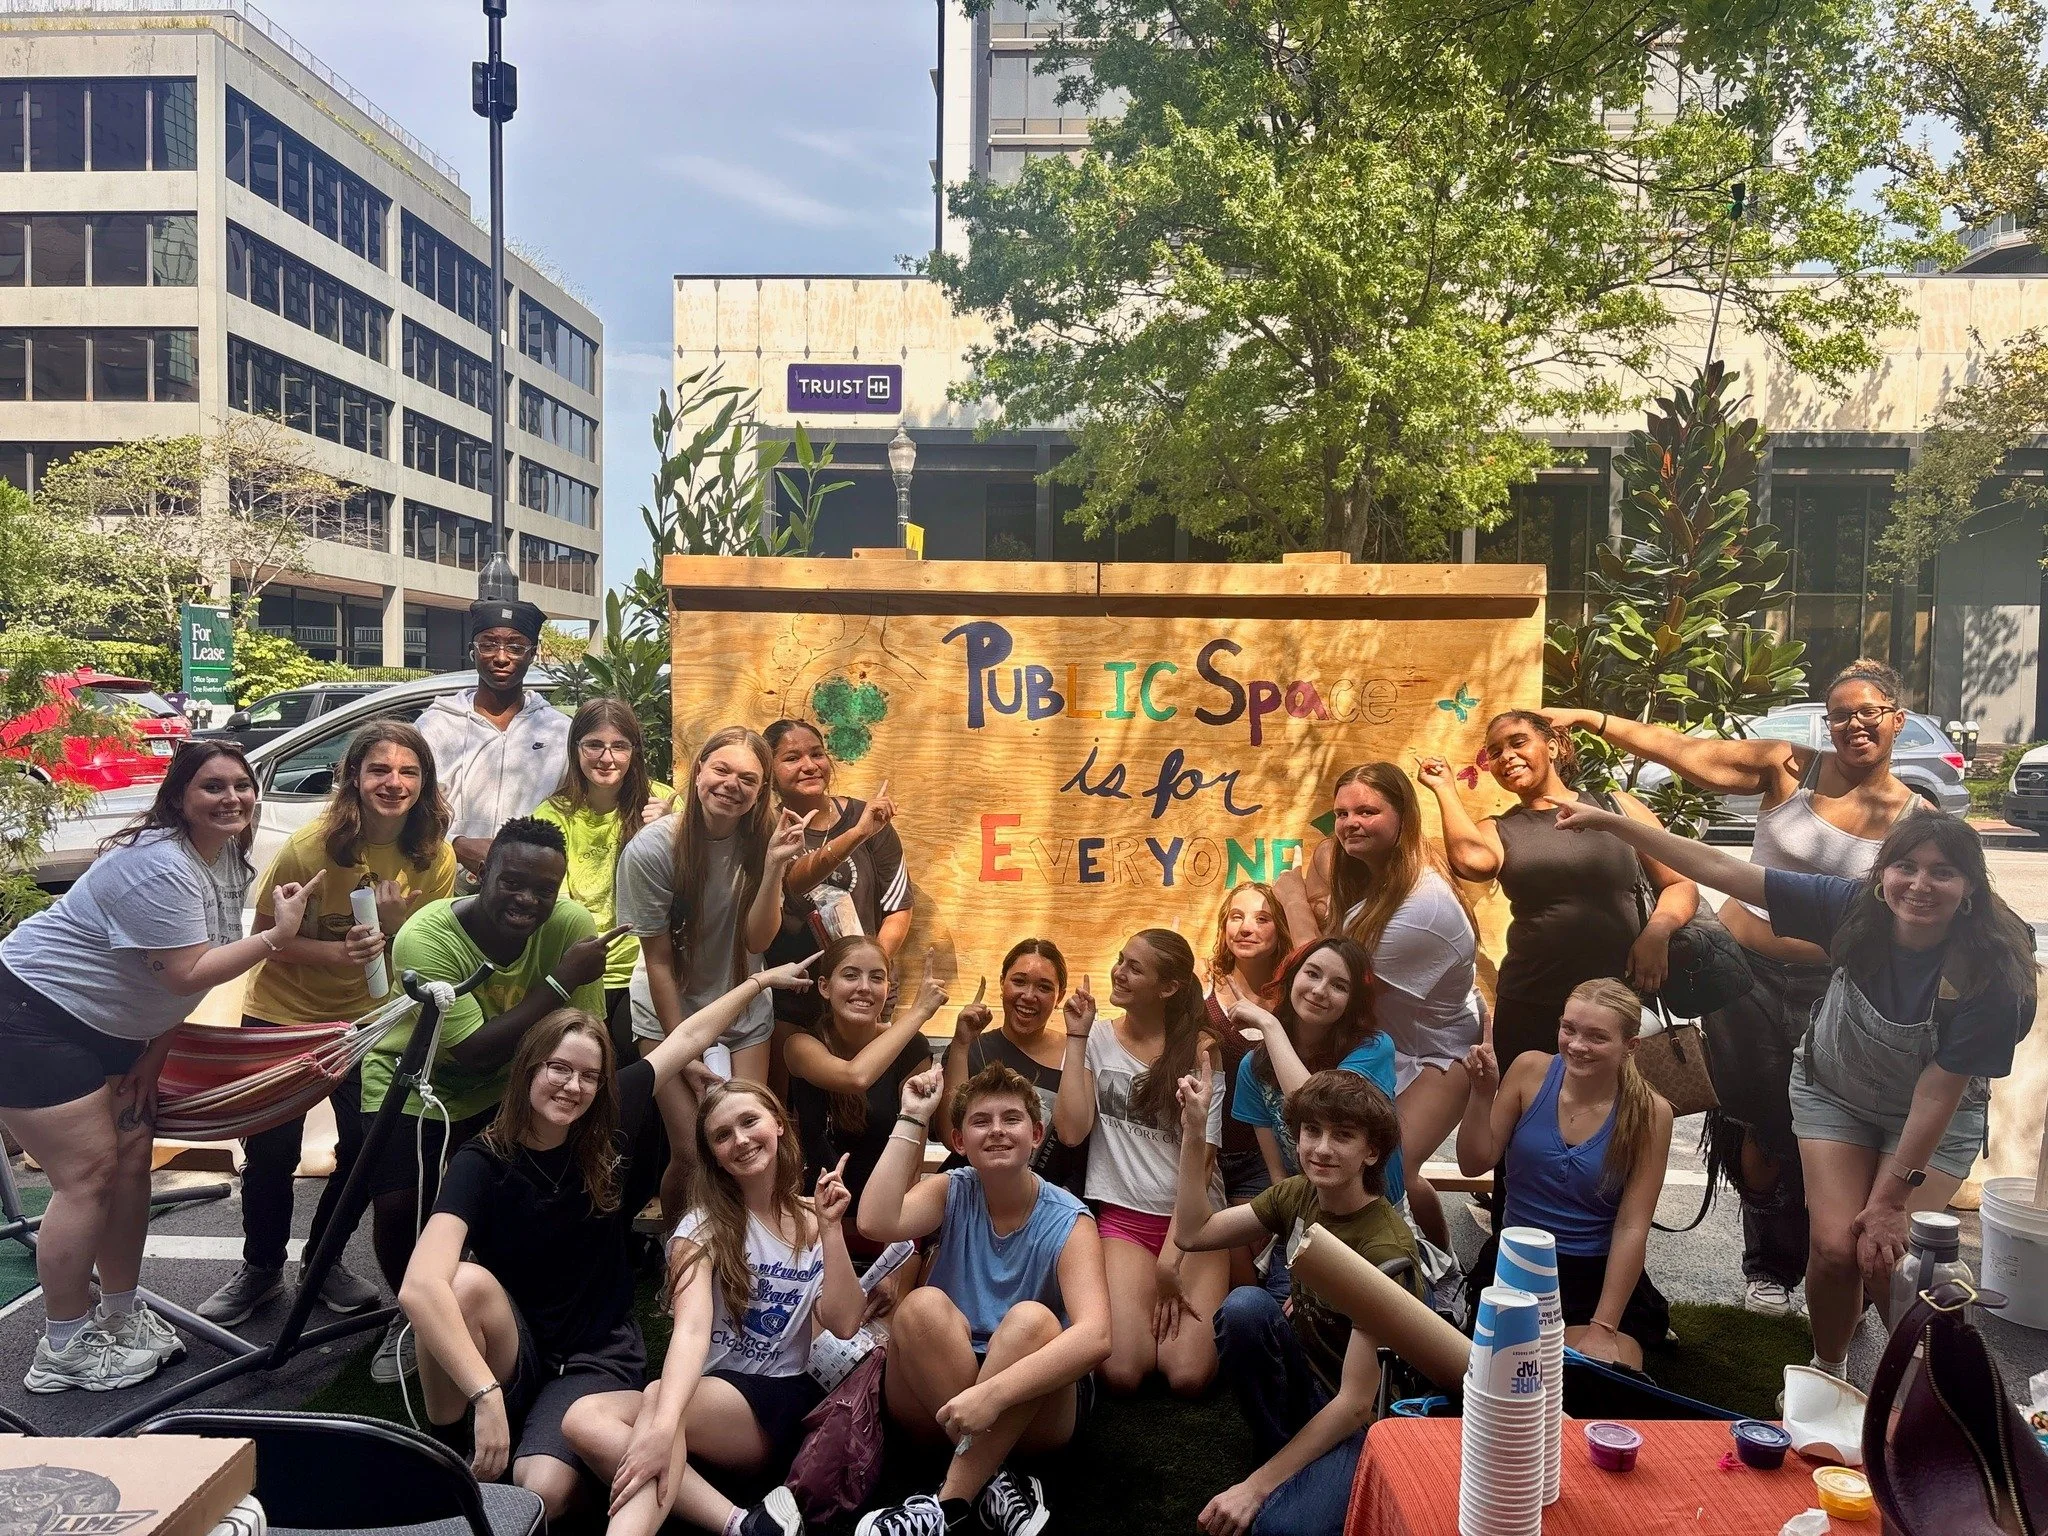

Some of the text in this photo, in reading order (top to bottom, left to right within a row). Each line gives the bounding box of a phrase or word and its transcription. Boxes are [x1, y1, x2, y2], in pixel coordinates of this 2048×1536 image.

[799, 379, 864, 394] TRUIST
[192, 623, 211, 642] For
[193, 642, 226, 661] Lease
[1194, 638, 1399, 747] Space
[1060, 737, 1264, 819] is for
[978, 814, 1304, 890] EVERYONE
[1100, 1116, 1124, 1130] NEW
[1127, 1125, 1159, 1142] YORK
